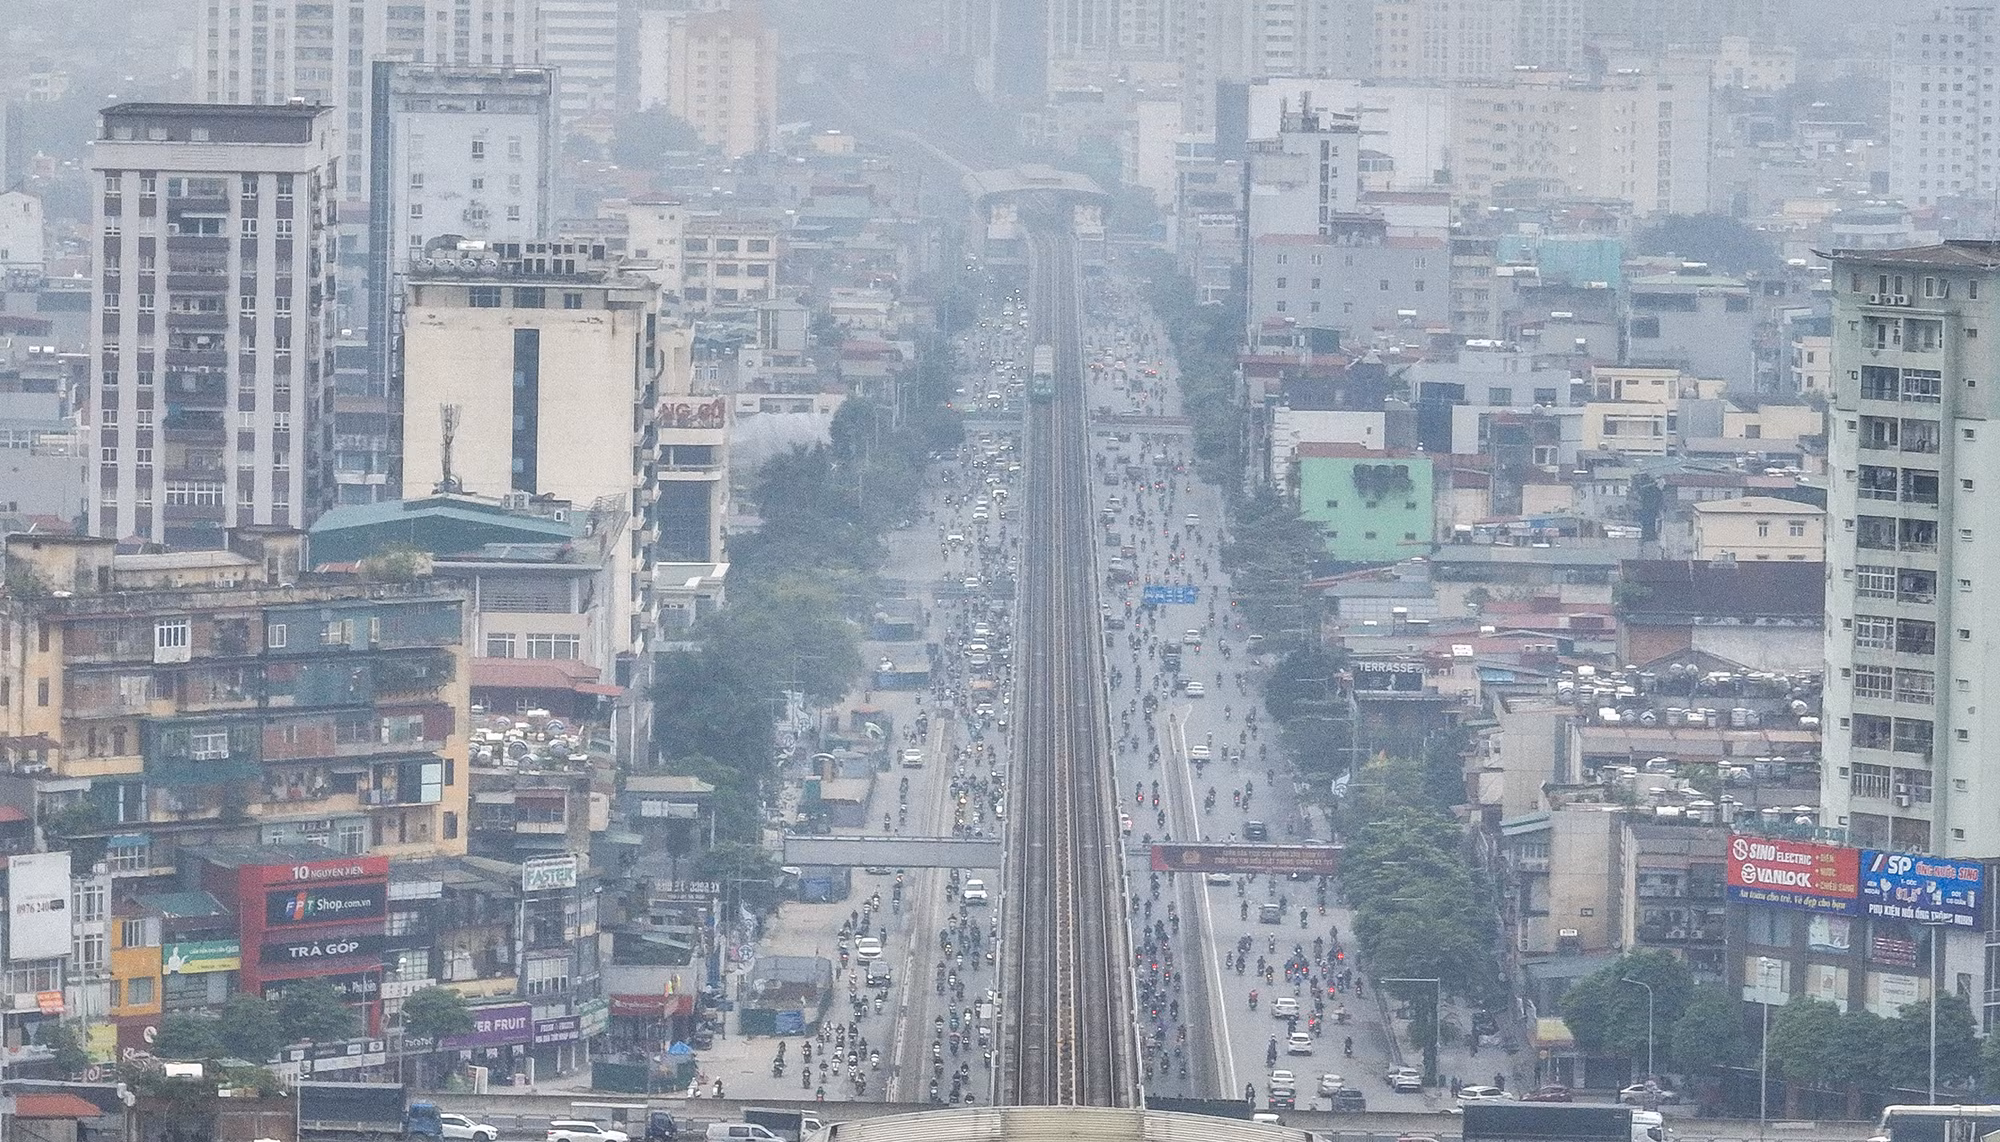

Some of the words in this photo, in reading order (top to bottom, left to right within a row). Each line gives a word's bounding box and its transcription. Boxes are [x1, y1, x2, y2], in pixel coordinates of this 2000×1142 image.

[1359, 662, 1415, 673] TERRASSE
[1749, 844, 1776, 861] SINO
[1776, 852, 1812, 866] ELECTRIC
[292, 866, 309, 880] 10
[1887, 855, 1912, 876] SP
[1957, 867, 1979, 882] SINO
[527, 867, 573, 886] FASTER
[1756, 867, 1812, 888] VANLOCK
[285, 897, 317, 914] FPT
[317, 897, 371, 912] Shop.com.vn
[289, 941, 322, 958] TRẢ
[325, 938, 359, 955] GÓP
[494, 1015, 526, 1031] FRUIT
